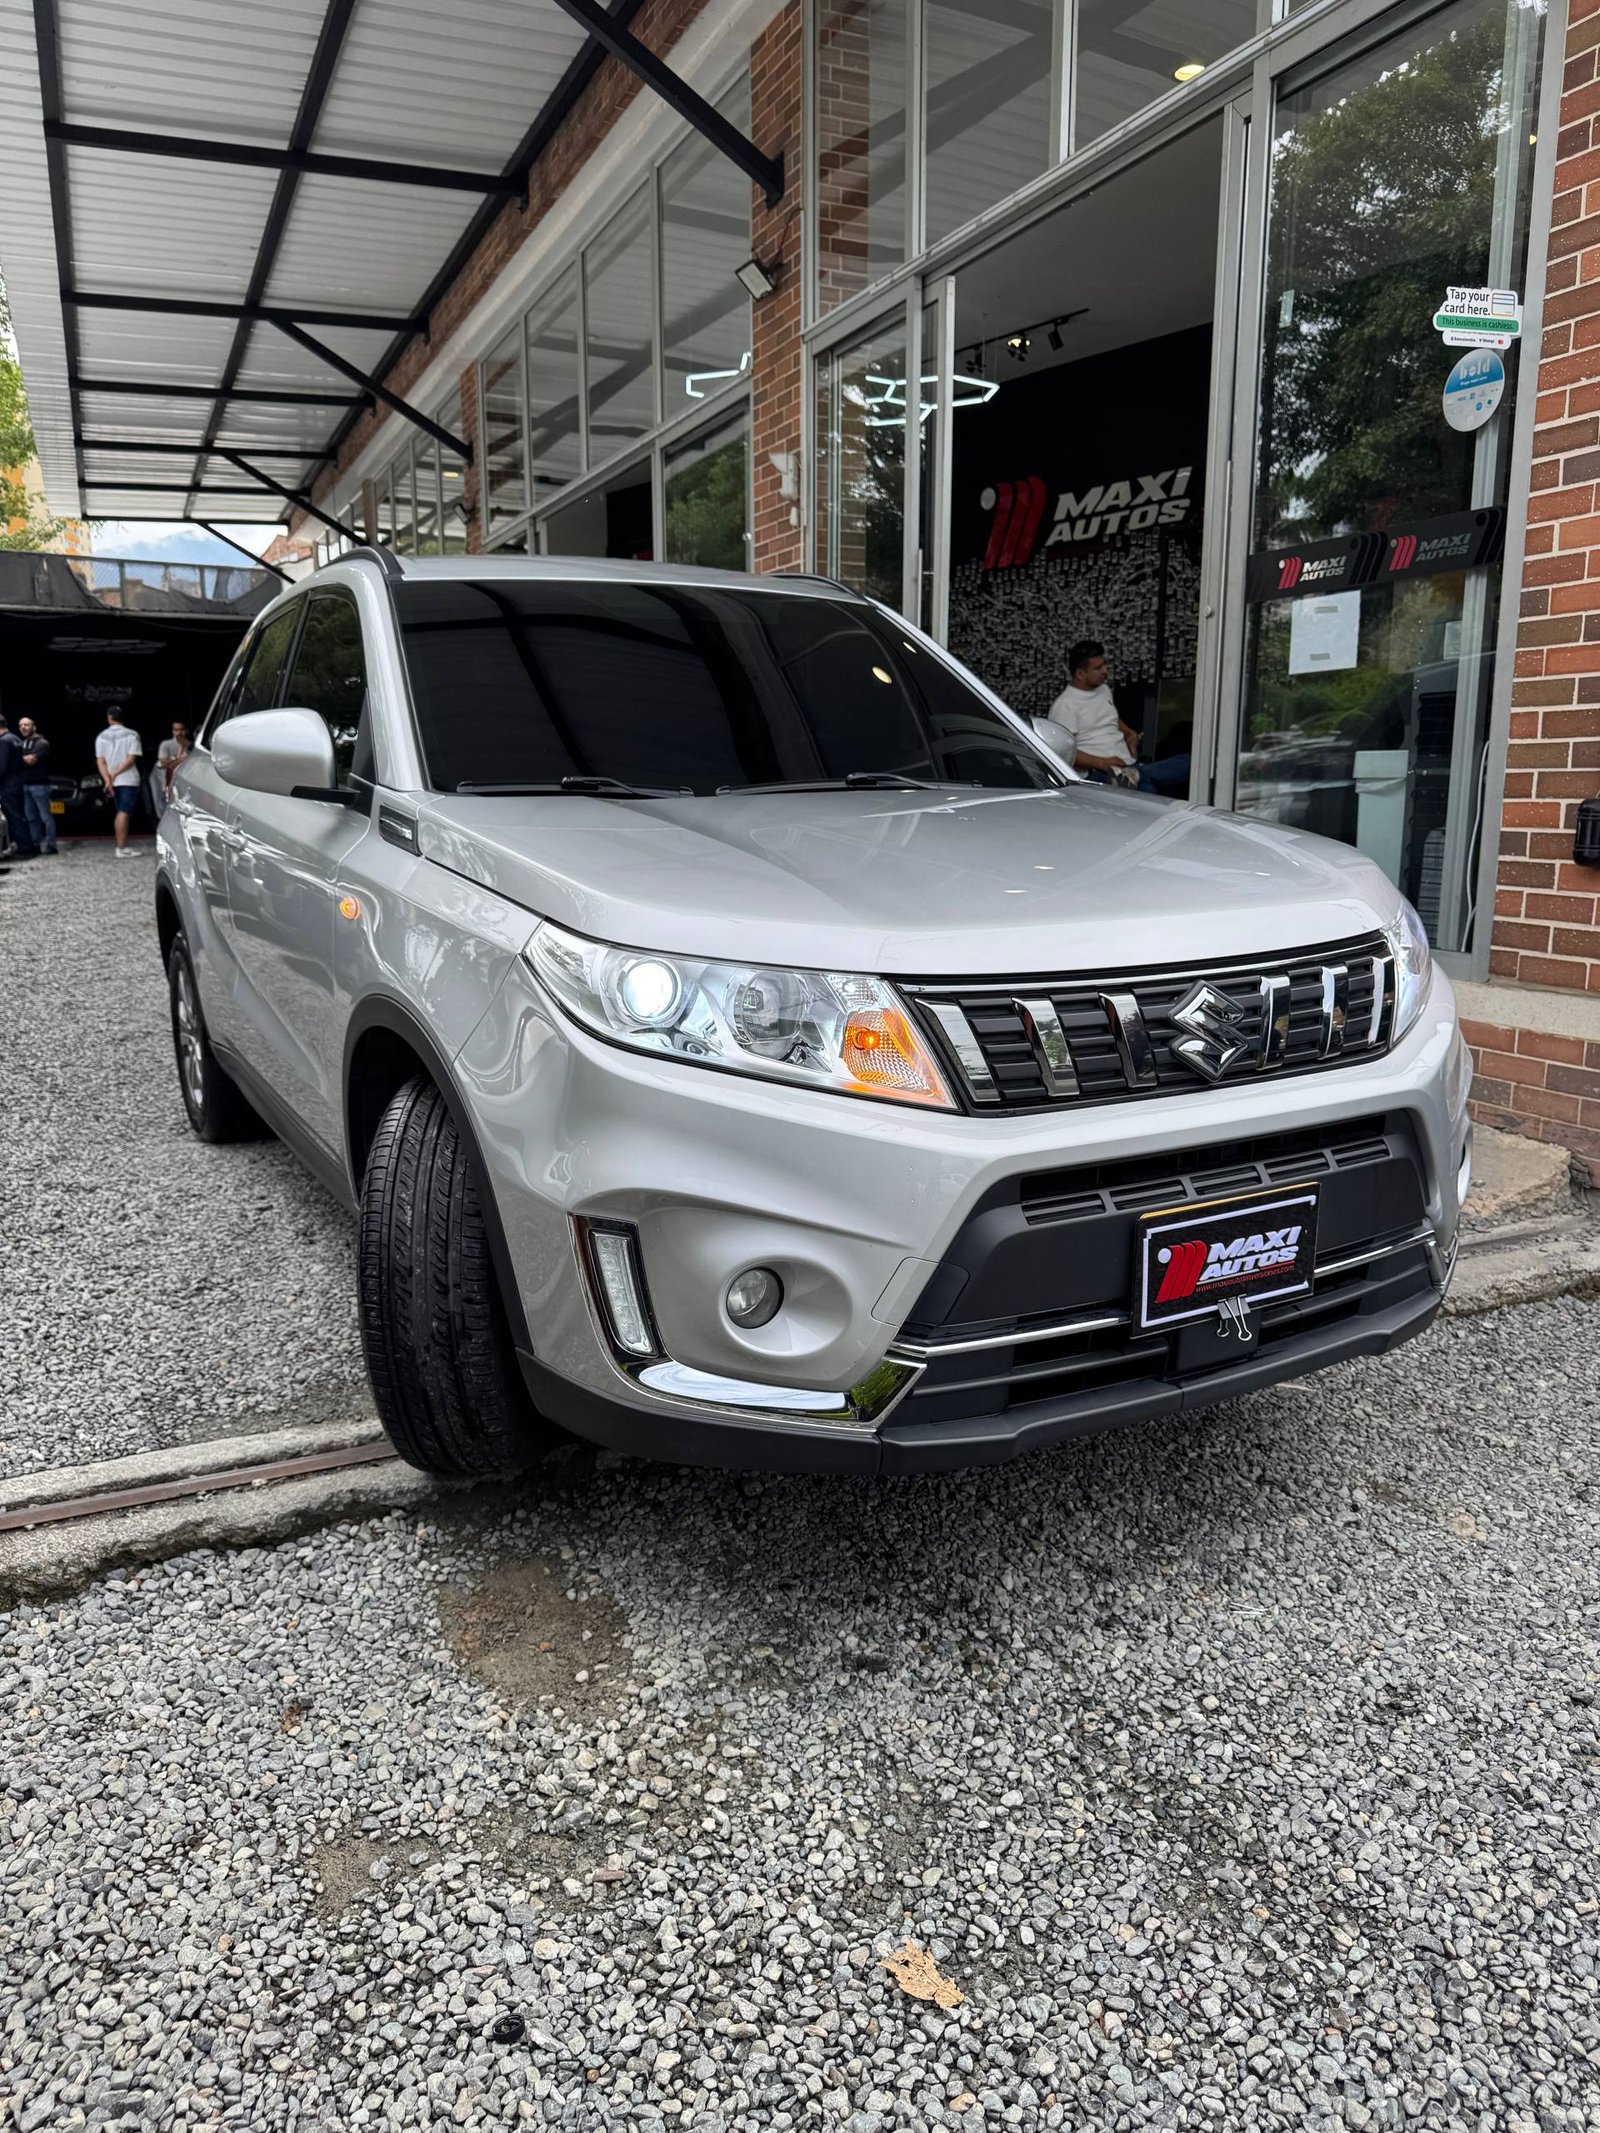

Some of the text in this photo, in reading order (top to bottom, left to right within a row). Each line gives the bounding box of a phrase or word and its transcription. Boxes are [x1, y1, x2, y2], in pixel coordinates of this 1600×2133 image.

[1450, 288, 1490, 303] Tap your
[1444, 303, 1491, 316] card here.
[1442, 317, 1455, 326] This
[1455, 318, 1481, 328] business
[1482, 319, 1487, 328] is
[1459, 358, 1491, 380] bold
[1053, 466, 1193, 521] MAXI
[1044, 498, 1191, 547] AUTOS
[1419, 533, 1472, 551] MAXI
[1415, 545, 1470, 562] AUTOS
[1302, 556, 1347, 573] MAXI
[1299, 567, 1345, 582] AUTOS
[1206, 1225, 1302, 1264] MAXI
[1198, 1246, 1299, 1281] AUTOS
